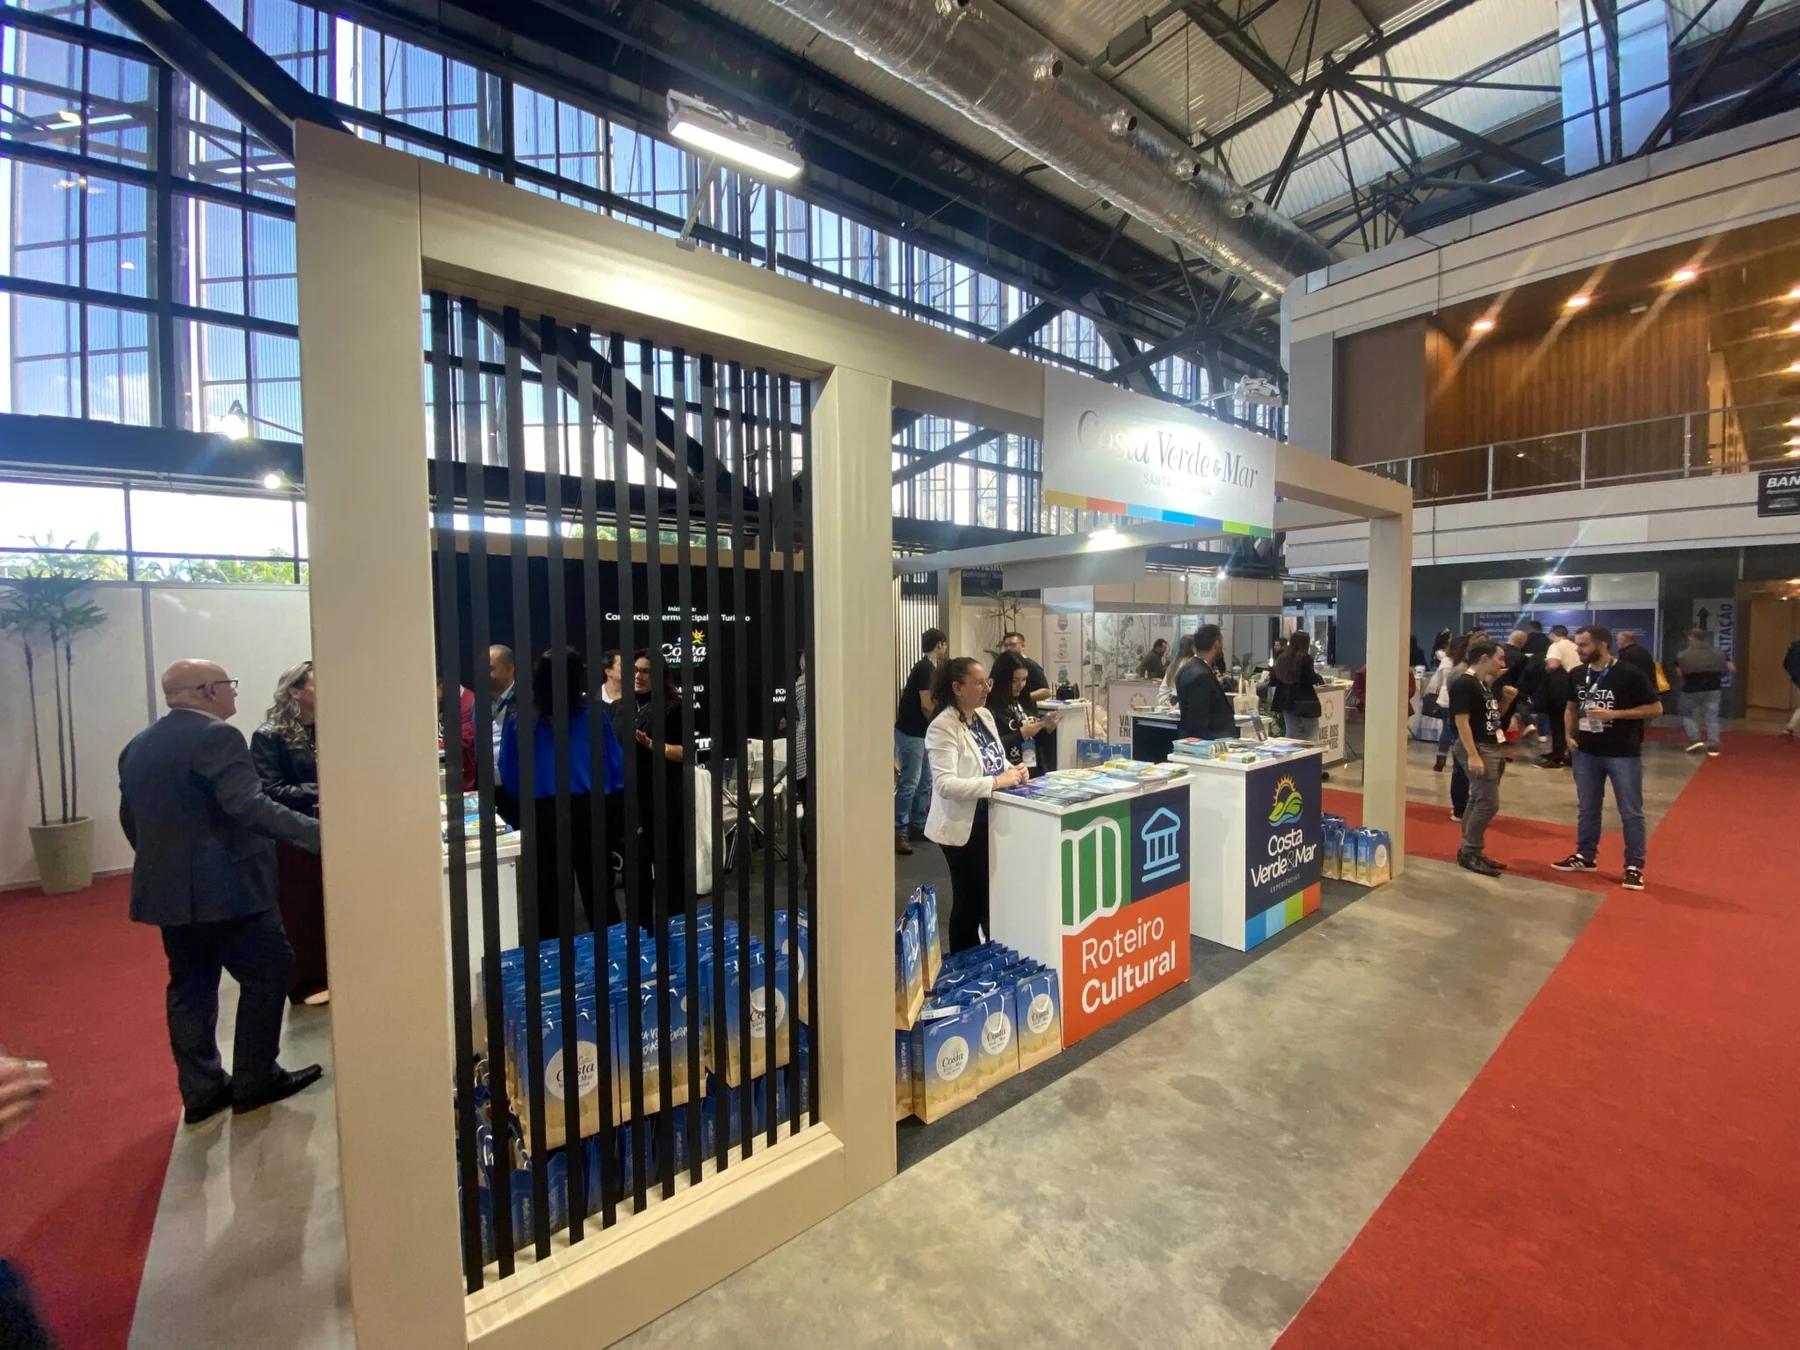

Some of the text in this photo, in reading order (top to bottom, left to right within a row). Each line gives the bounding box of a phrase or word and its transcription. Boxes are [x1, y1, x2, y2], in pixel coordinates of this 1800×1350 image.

[1157, 430, 1210, 478] Verde
[1223, 450, 1259, 489] Mar
[1268, 828, 1303, 856] Costa
[1082, 917, 1165, 975] Roteiro
[1081, 939, 1176, 1014] Cultural
[556, 1063, 595, 1083] Csta
